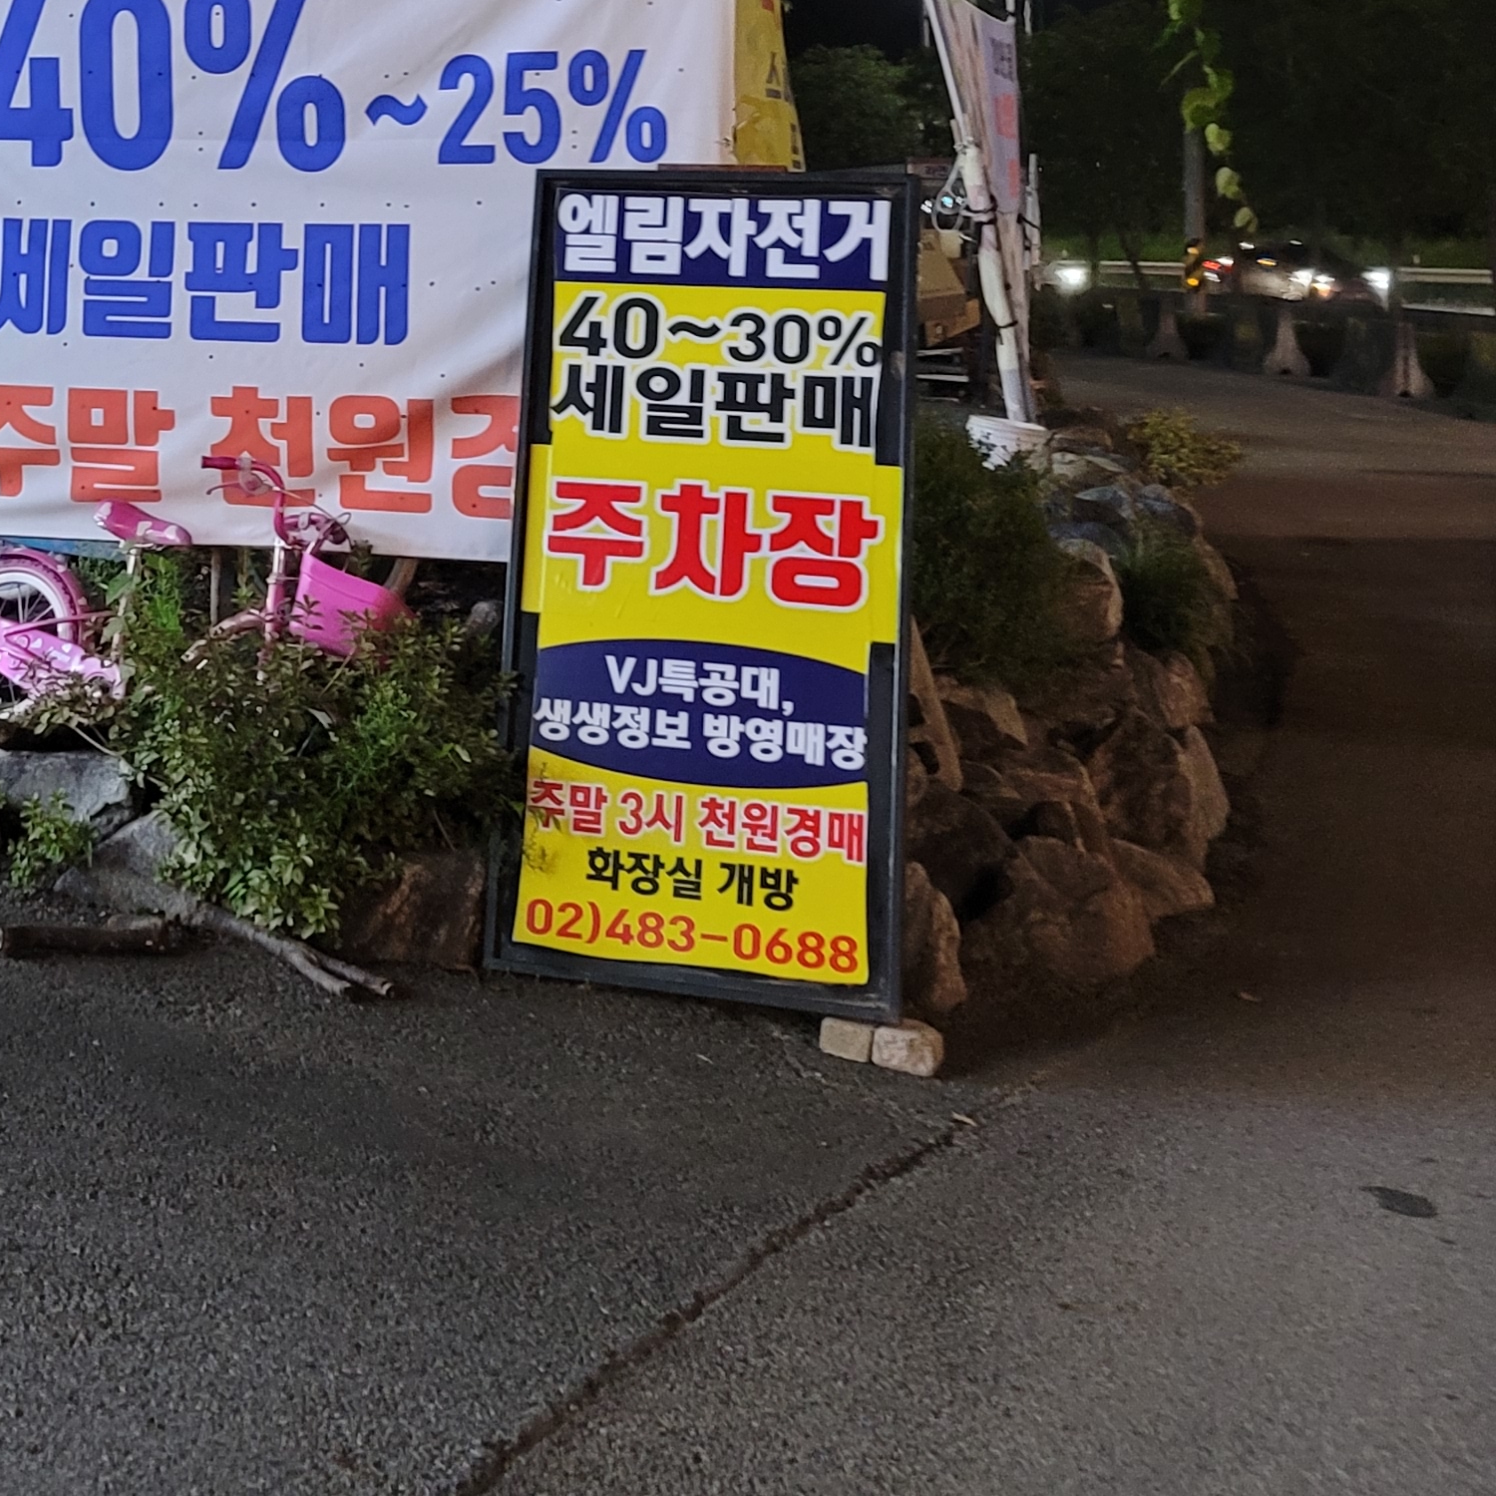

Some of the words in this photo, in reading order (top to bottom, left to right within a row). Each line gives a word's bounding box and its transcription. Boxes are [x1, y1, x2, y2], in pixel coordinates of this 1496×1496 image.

[557, 194, 892, 282] 엘림자전거
[558, 295, 882, 368] 40~30%
[551, 364, 875, 448] 세일판매
[547, 481, 879, 604] 주차장
[605, 654, 794, 715] VJ특공대,
[533, 697, 692, 751] 생생정보
[703, 712, 868, 771] 방영매장
[529, 779, 607, 835] 주말
[618, 791, 684, 843] 3시
[699, 797, 865, 864] 천원경매
[586, 847, 703, 901] 화장실
[717, 861, 799, 912] 개방
[525, 898, 859, 974] 02)483-0688
